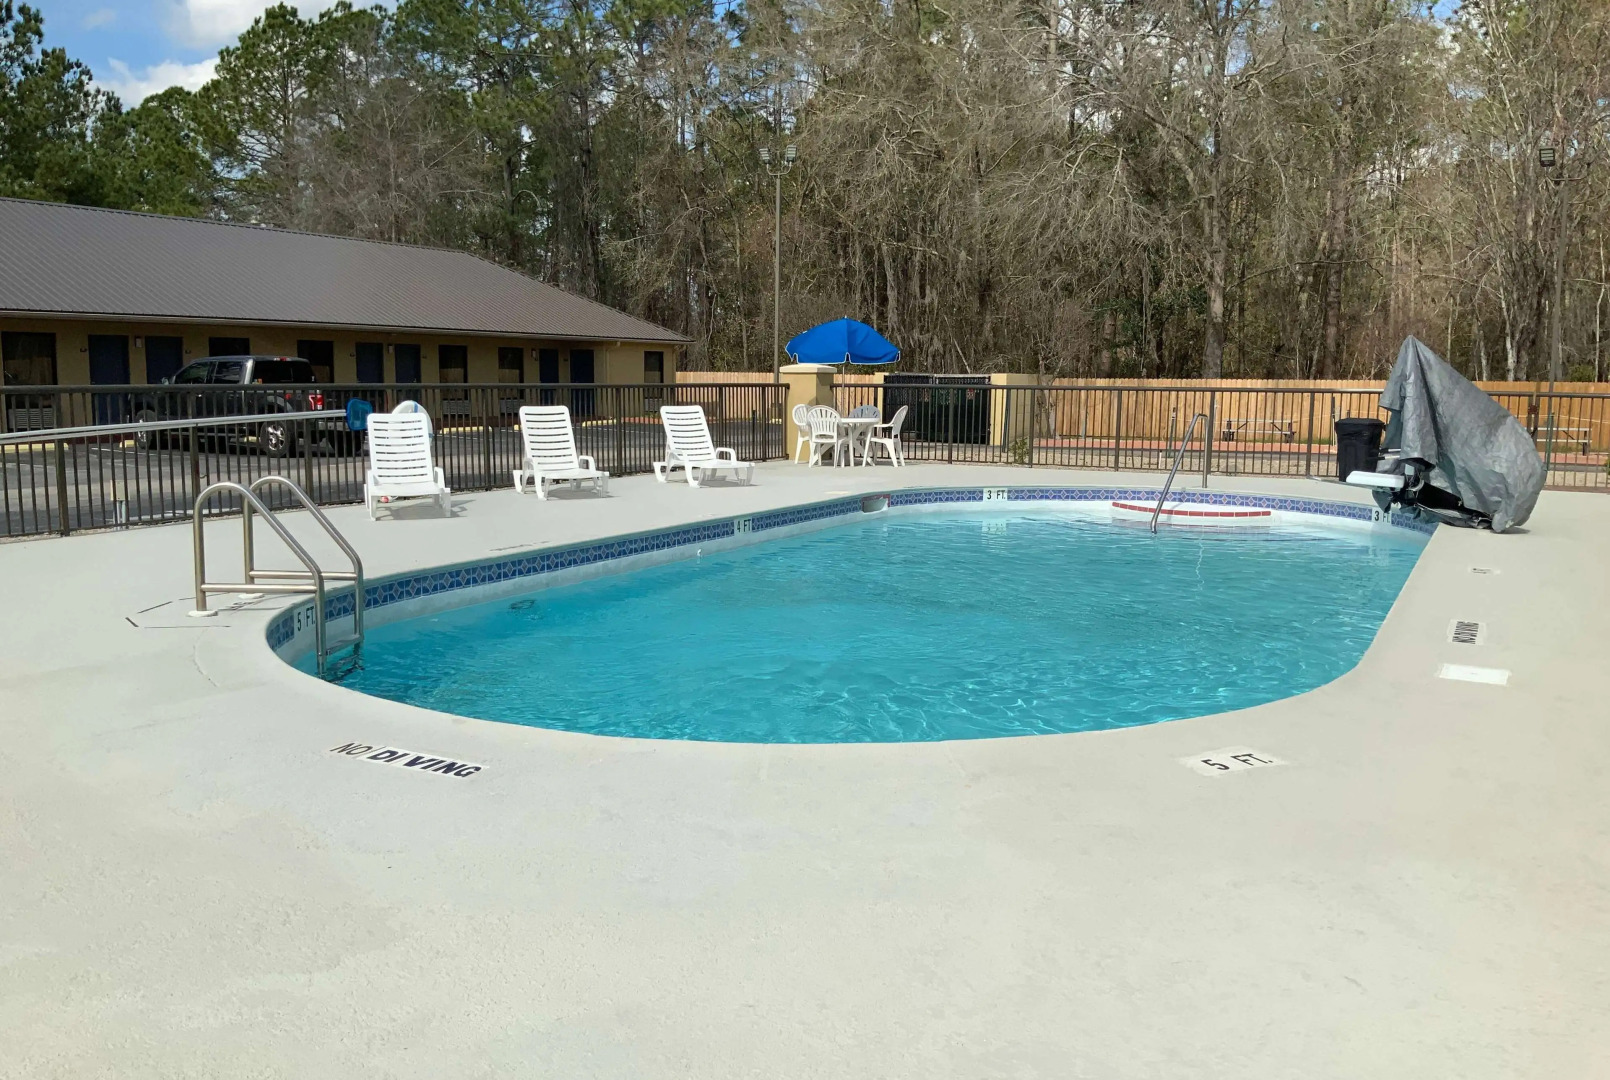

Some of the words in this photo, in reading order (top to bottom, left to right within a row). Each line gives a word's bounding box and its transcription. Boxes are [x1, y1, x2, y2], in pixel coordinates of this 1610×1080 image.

[986, 490, 992, 500] 3
[1374, 511, 1380, 522] 3
[737, 521, 741, 532] 4
[297, 611, 302, 632] 5
[330, 743, 373, 755] NO
[366, 750, 482, 777] DIVING
[1201, 759, 1230, 770] 5
